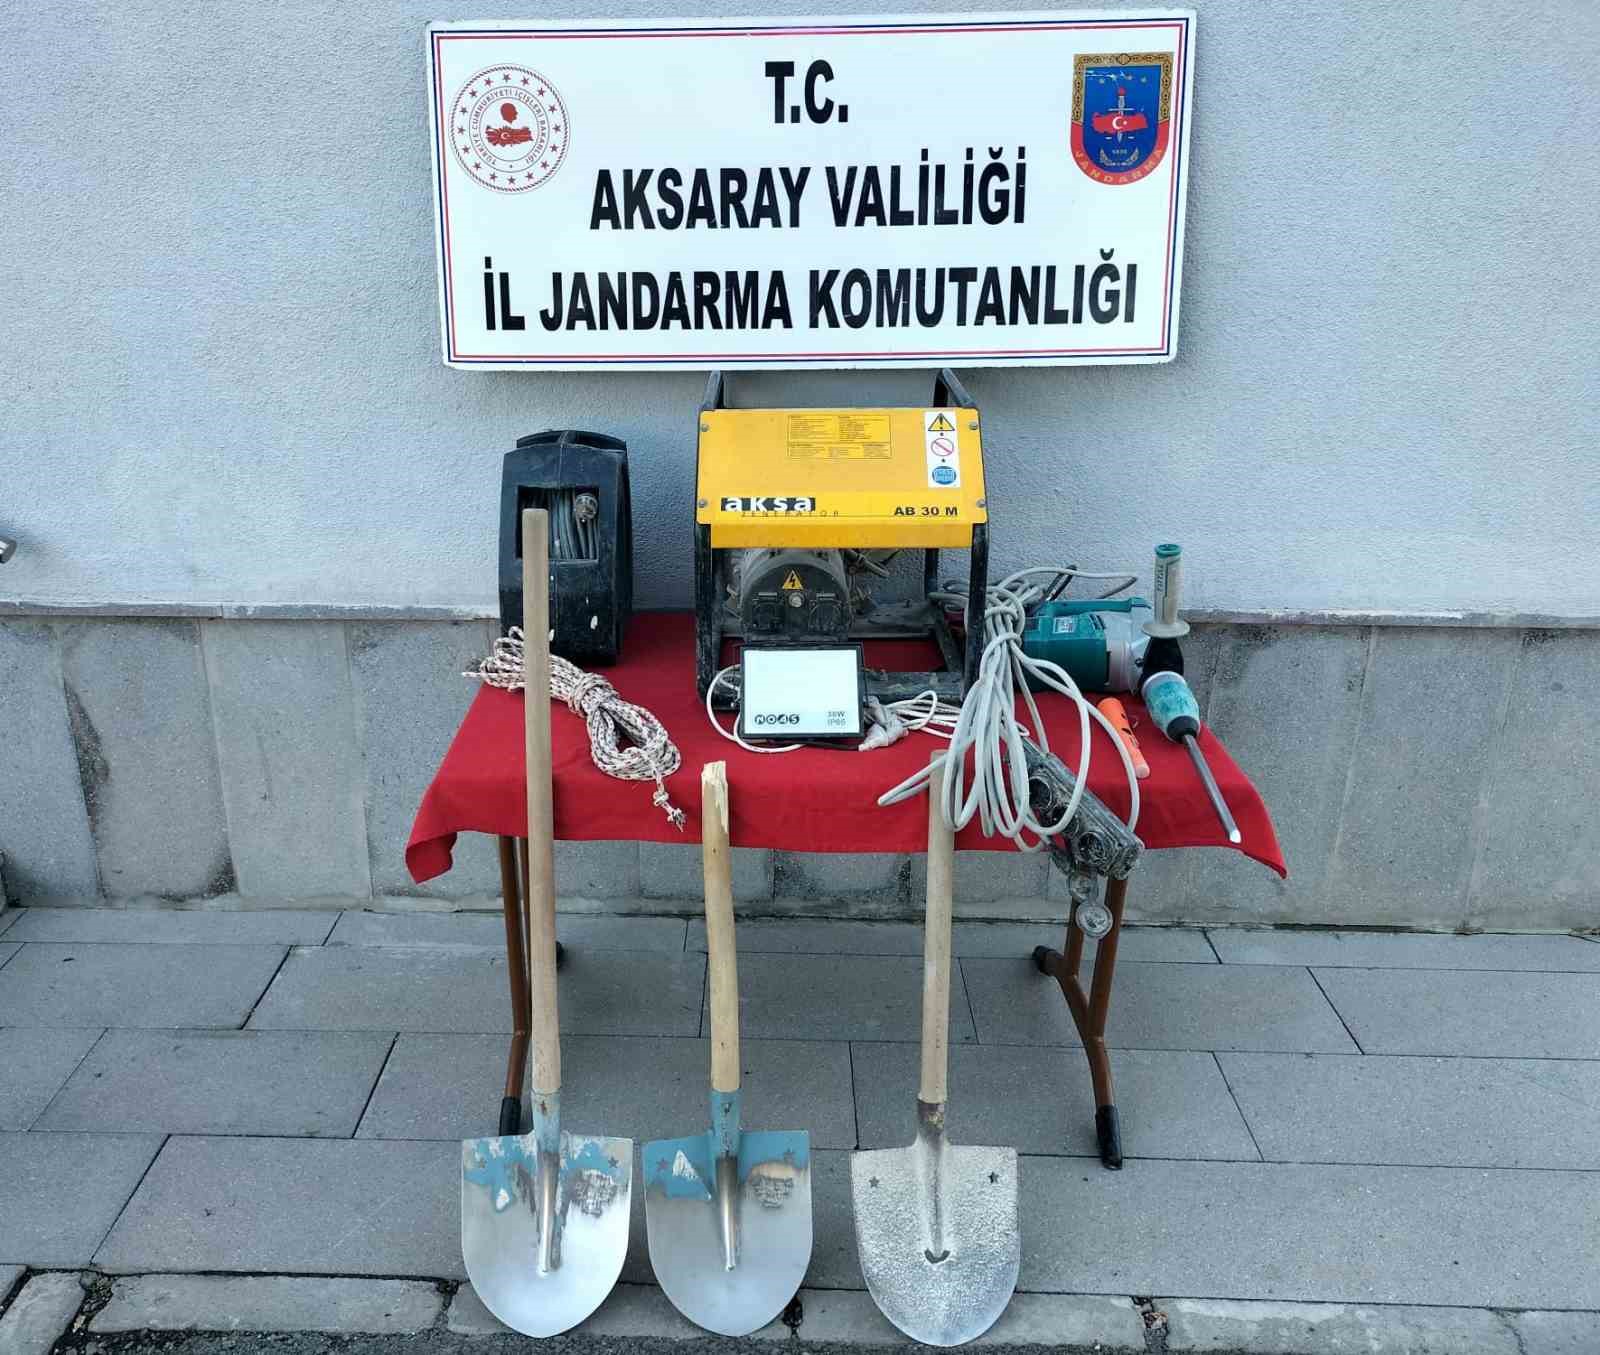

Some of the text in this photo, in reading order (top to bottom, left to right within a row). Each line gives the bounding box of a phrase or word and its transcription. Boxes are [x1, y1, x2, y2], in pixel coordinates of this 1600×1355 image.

[765, 60, 850, 124] T.C.
[590, 146, 1027, 231] AKSARAY VALİLİĞİ
[484, 248, 1138, 333] İL JANDARMA KOMUTANLIĞI
[723, 496, 814, 512] aksa
[894, 506, 958, 516] AB 30 M
